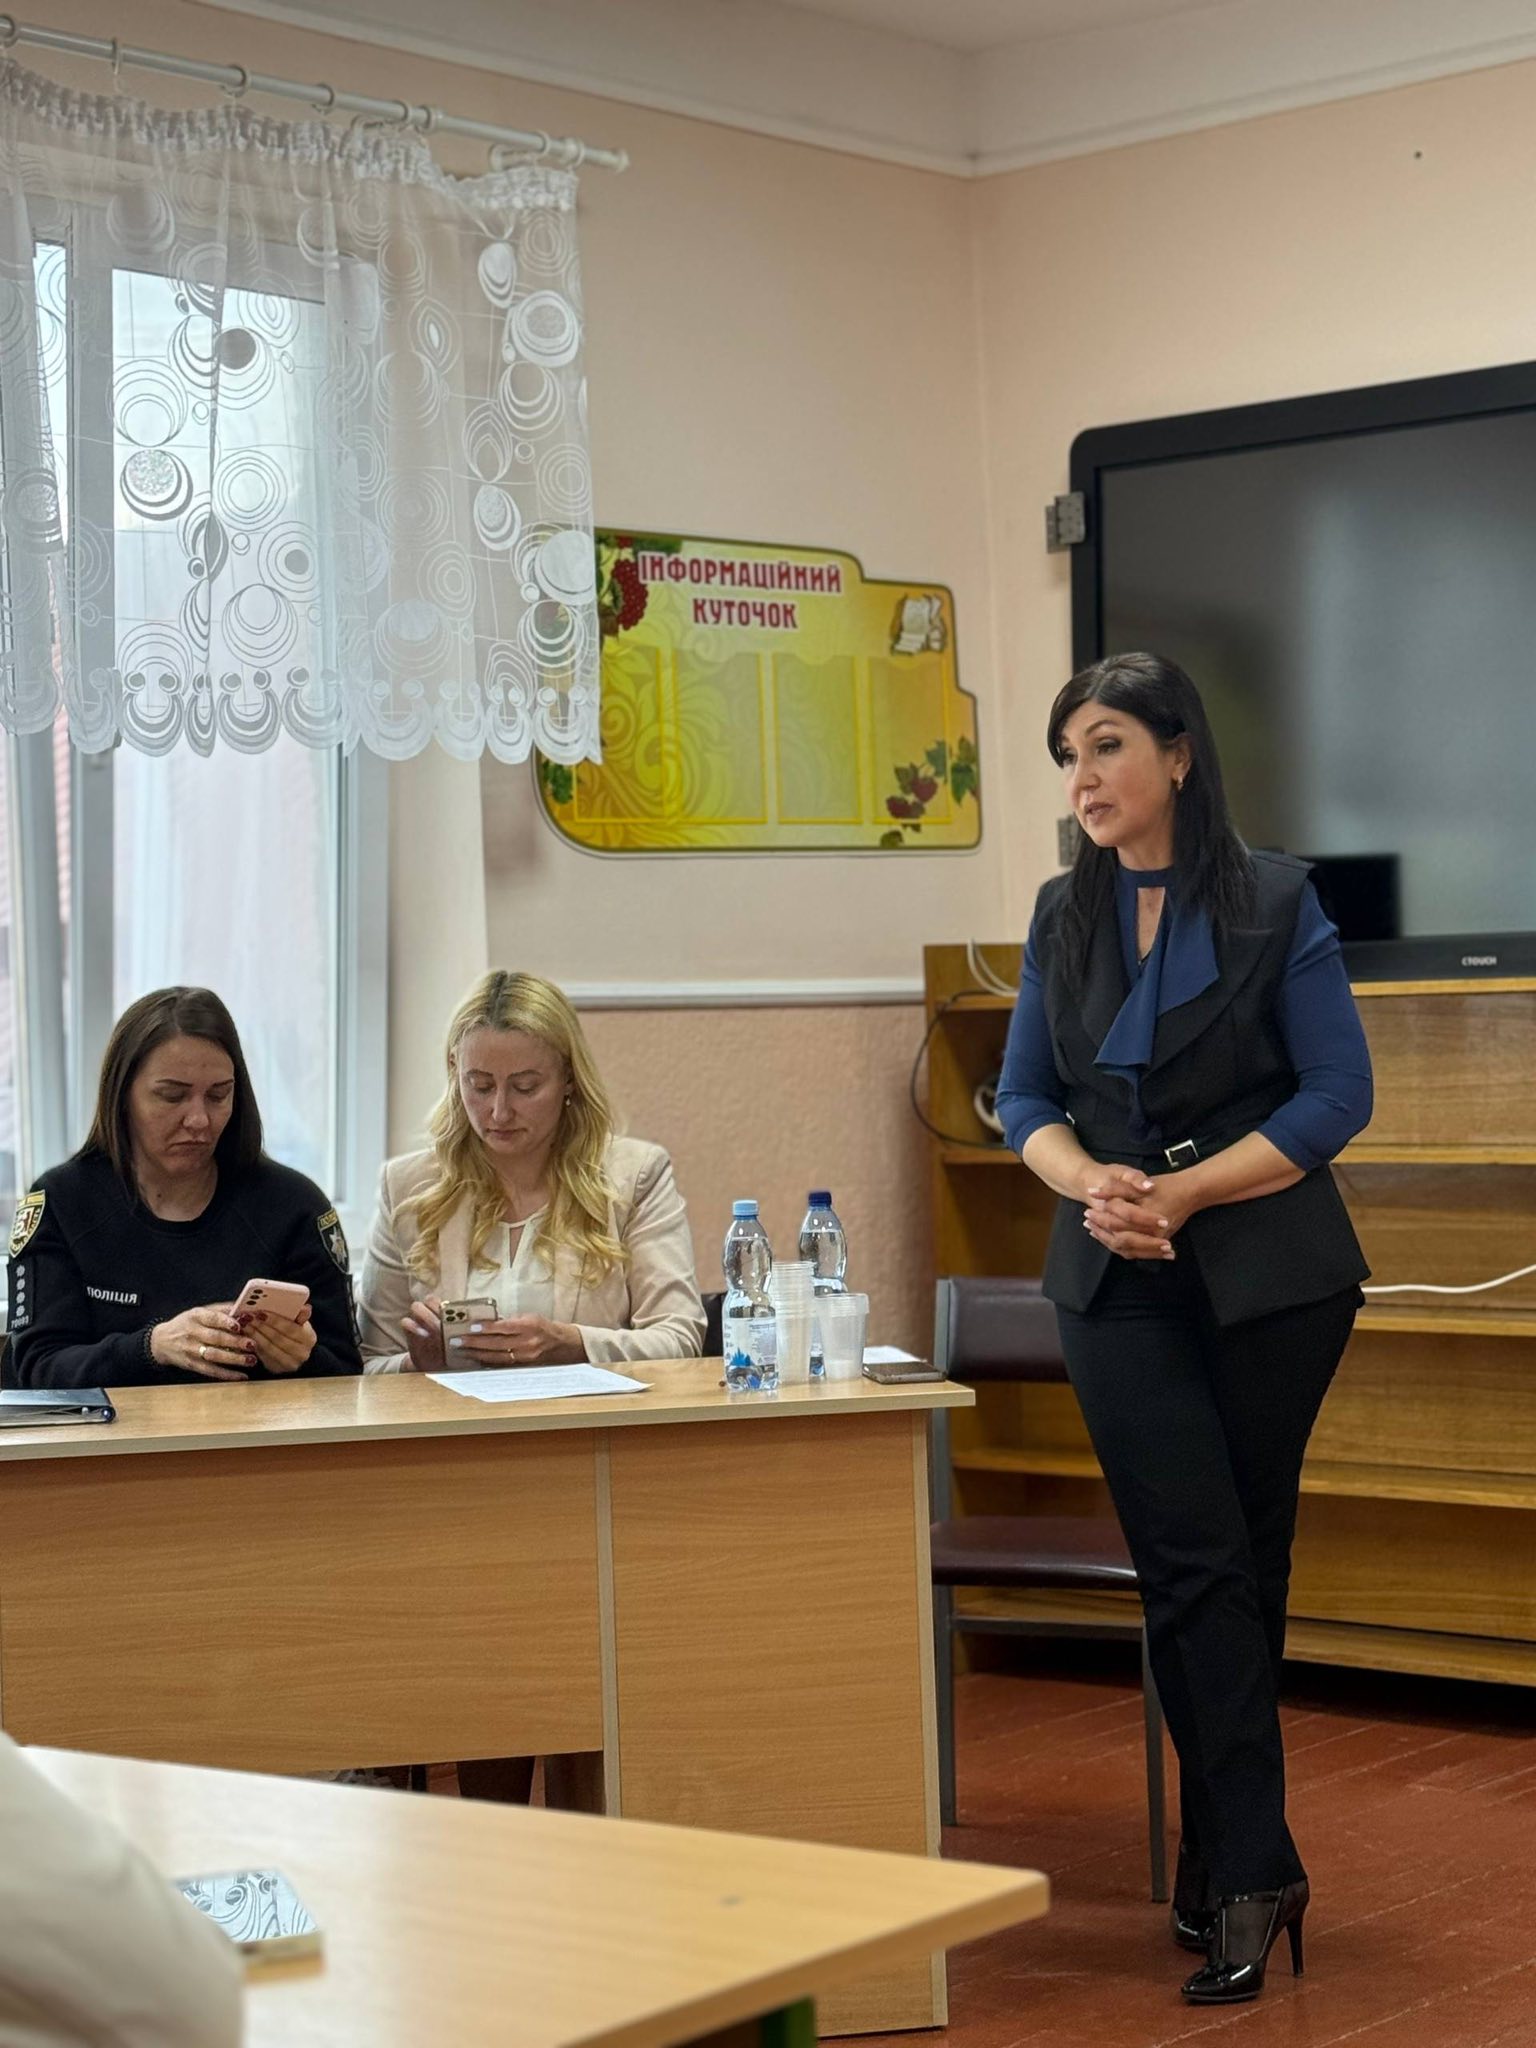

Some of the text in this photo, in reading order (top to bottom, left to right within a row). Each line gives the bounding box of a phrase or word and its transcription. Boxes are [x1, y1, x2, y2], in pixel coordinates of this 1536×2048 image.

[641, 555, 841, 593] ІНФОРМАЦІЙНИЙ
[693, 598, 797, 629] КУТОЧОК
[1461, 956, 1497, 967] CTOUCH
[86, 1286, 138, 1304] ПОЛІЦІЯ
